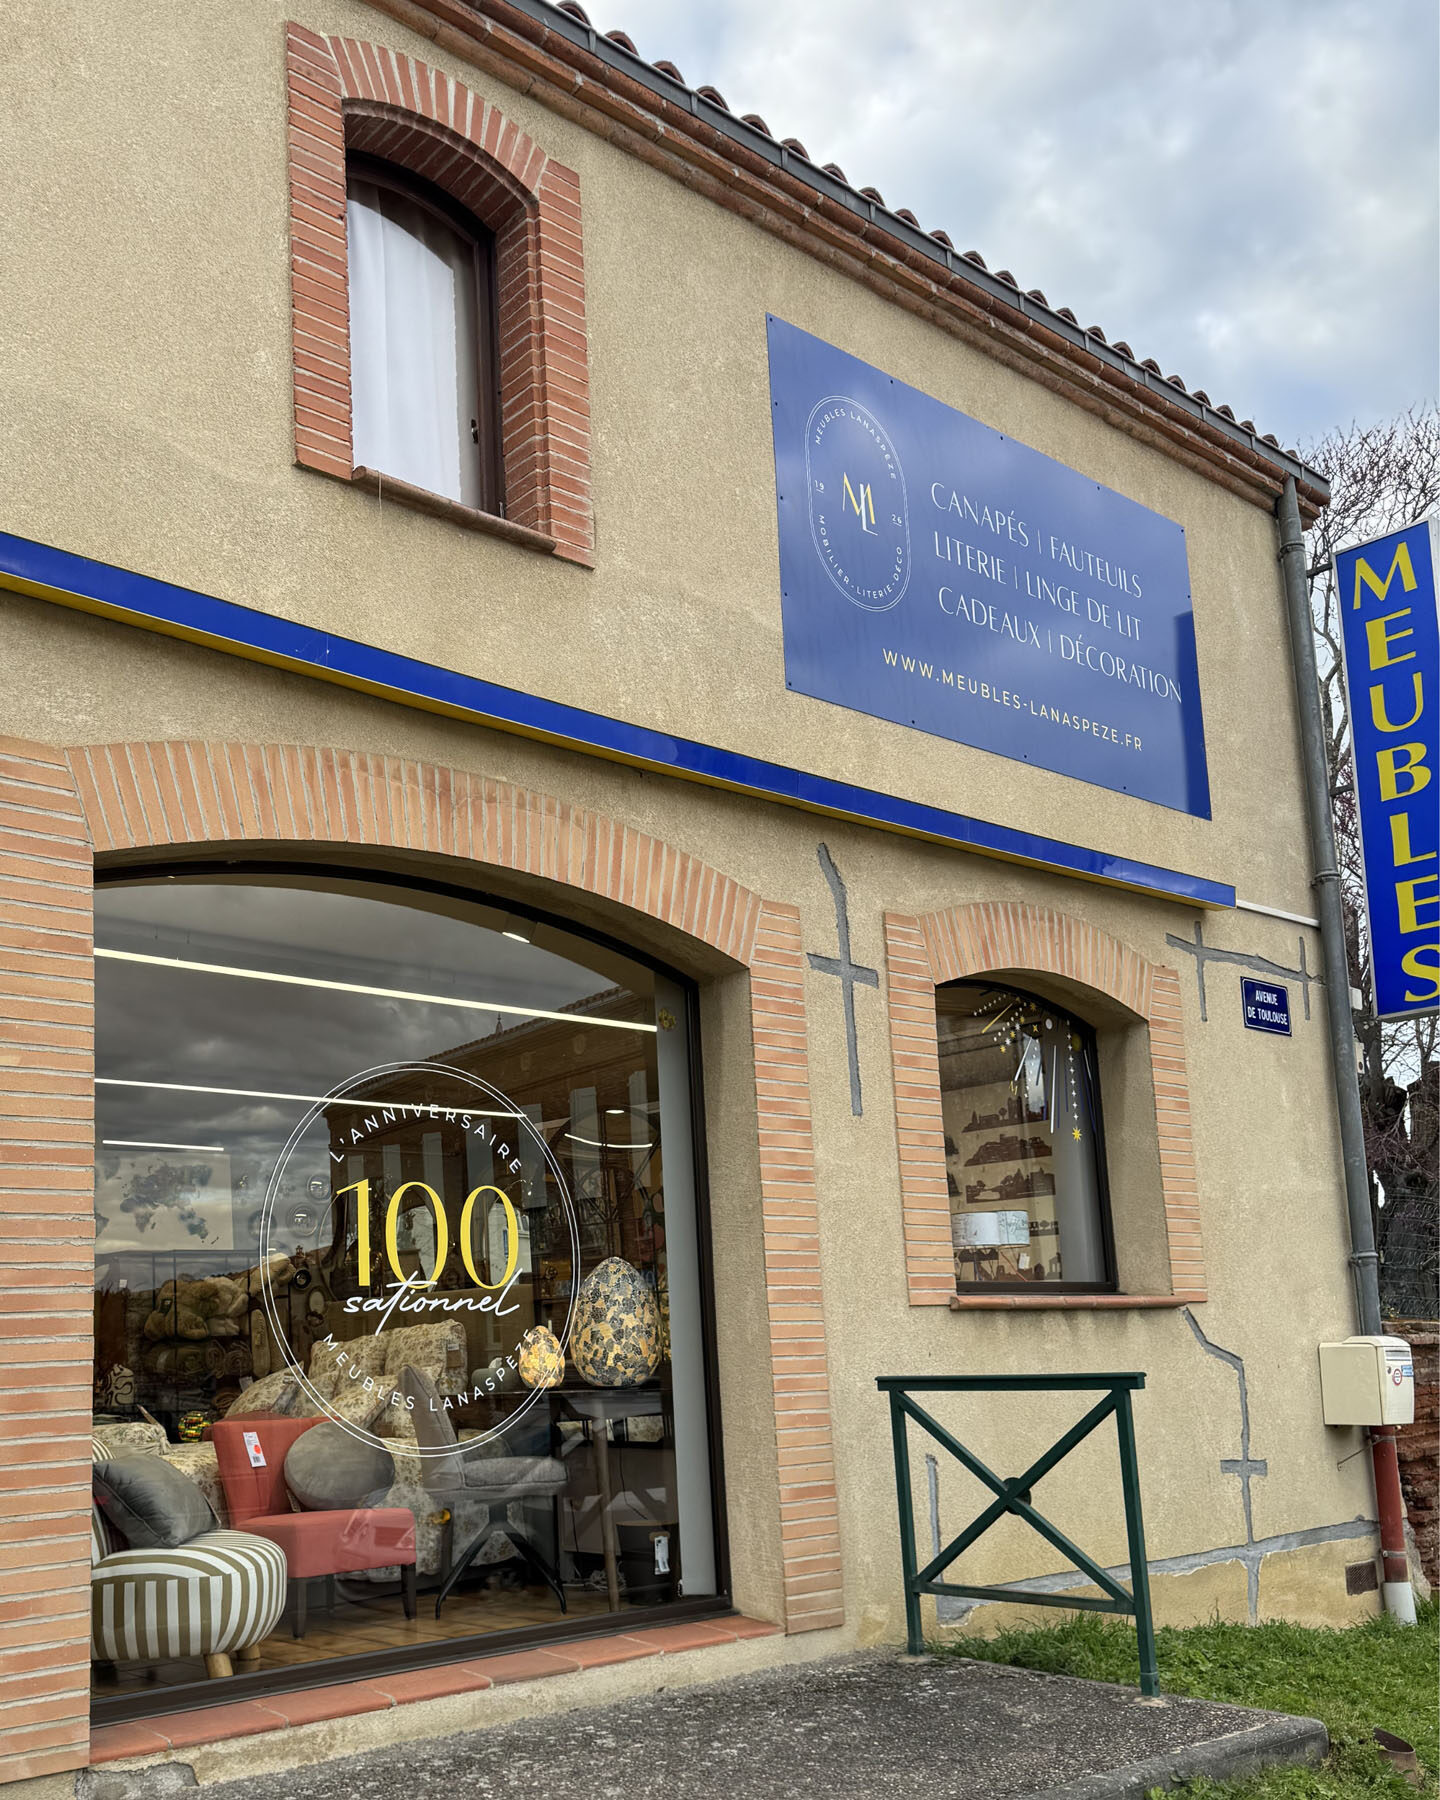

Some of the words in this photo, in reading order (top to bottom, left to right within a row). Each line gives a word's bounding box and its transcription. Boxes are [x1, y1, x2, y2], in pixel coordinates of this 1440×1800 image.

[815, 408, 846, 445] MEUBLES
[815, 480, 824, 490] 19
[931, 482, 1029, 547] CANAPÉS
[1050, 535, 1142, 599] FAUTEUILS
[934, 531, 1007, 585] LITERIE
[1026, 571, 1081, 617] LINGE
[1087, 597, 1112, 629] DE
[1117, 610, 1141, 641] LIT
[939, 586, 1041, 649] CADEAUX
[1060, 634, 1182, 704] DÉCORATION
[882, 648, 1142, 751] WWW.MEUBLES-LANASPEZE.FR
[1353, 541, 1439, 1002] MEUBLES
[1247, 1006, 1256, 1019] DE
[1257, 1008, 1288, 1025] TOULOUSE
[1255, 990, 1278, 1006] AVENUE
[330, 1103, 522, 1174] L'ANNIVERSAIRE
[336, 1179, 519, 1290] 100
[343, 1268, 523, 1336] sationnel
[323, 1332, 415, 1410] MEUBLES
